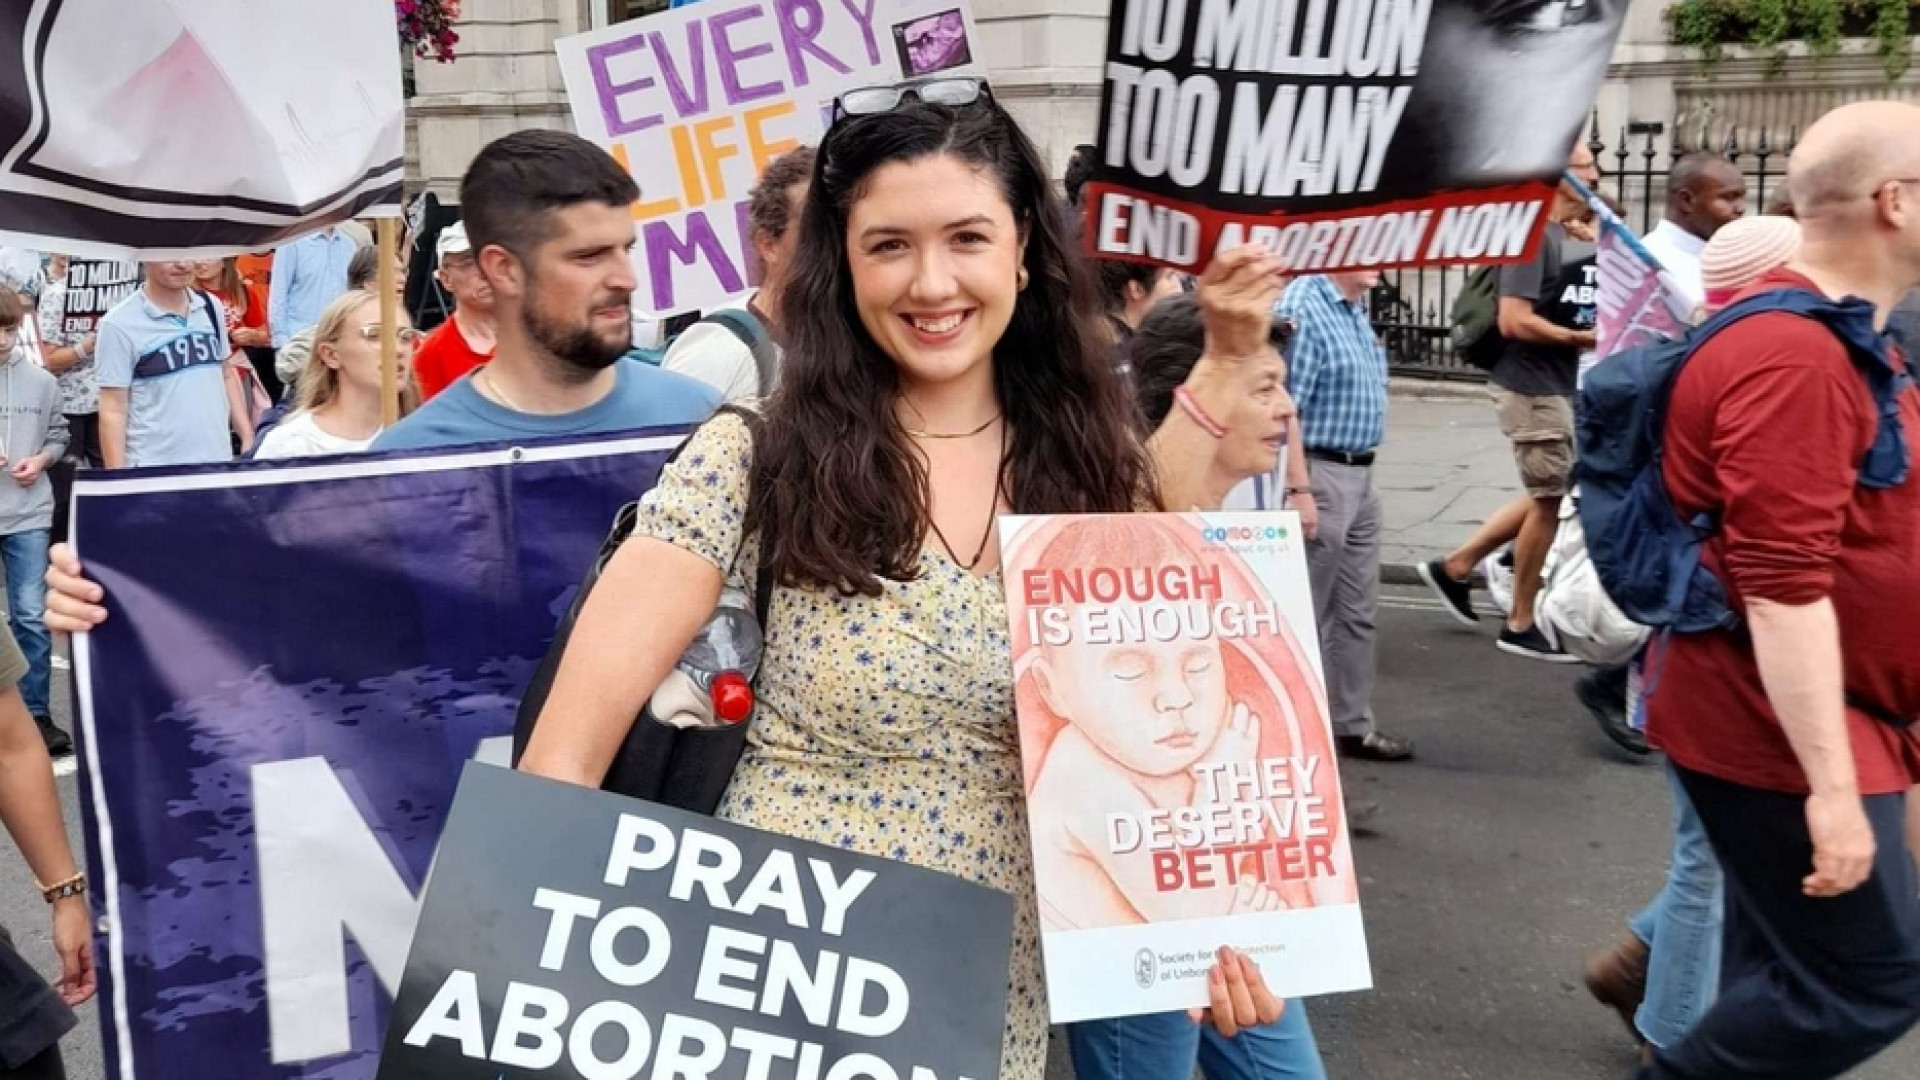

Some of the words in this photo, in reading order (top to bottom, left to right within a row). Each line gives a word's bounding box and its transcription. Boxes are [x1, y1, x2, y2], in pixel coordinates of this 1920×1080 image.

[586, 0, 881, 138] EVERY
[1193, 0, 1433, 77] MILLION
[612, 101, 802, 220] LIFE
[1105, 61, 1221, 187] TOO
[1219, 82, 1413, 196] MANY
[1097, 192, 1200, 266] END
[1425, 200, 1543, 260] NOW
[1022, 564, 1222, 605] ENOUGH
[1028, 606, 1072, 646] IS
[1082, 601, 1280, 645] ENOUGH
[1196, 755, 1320, 803] THEY
[1106, 796, 1328, 854] DESERVE
[604, 812, 877, 936] PRAY
[1153, 838, 1336, 892] BETTER
[531, 887, 671, 986] TO
[694, 925, 910, 1038] END
